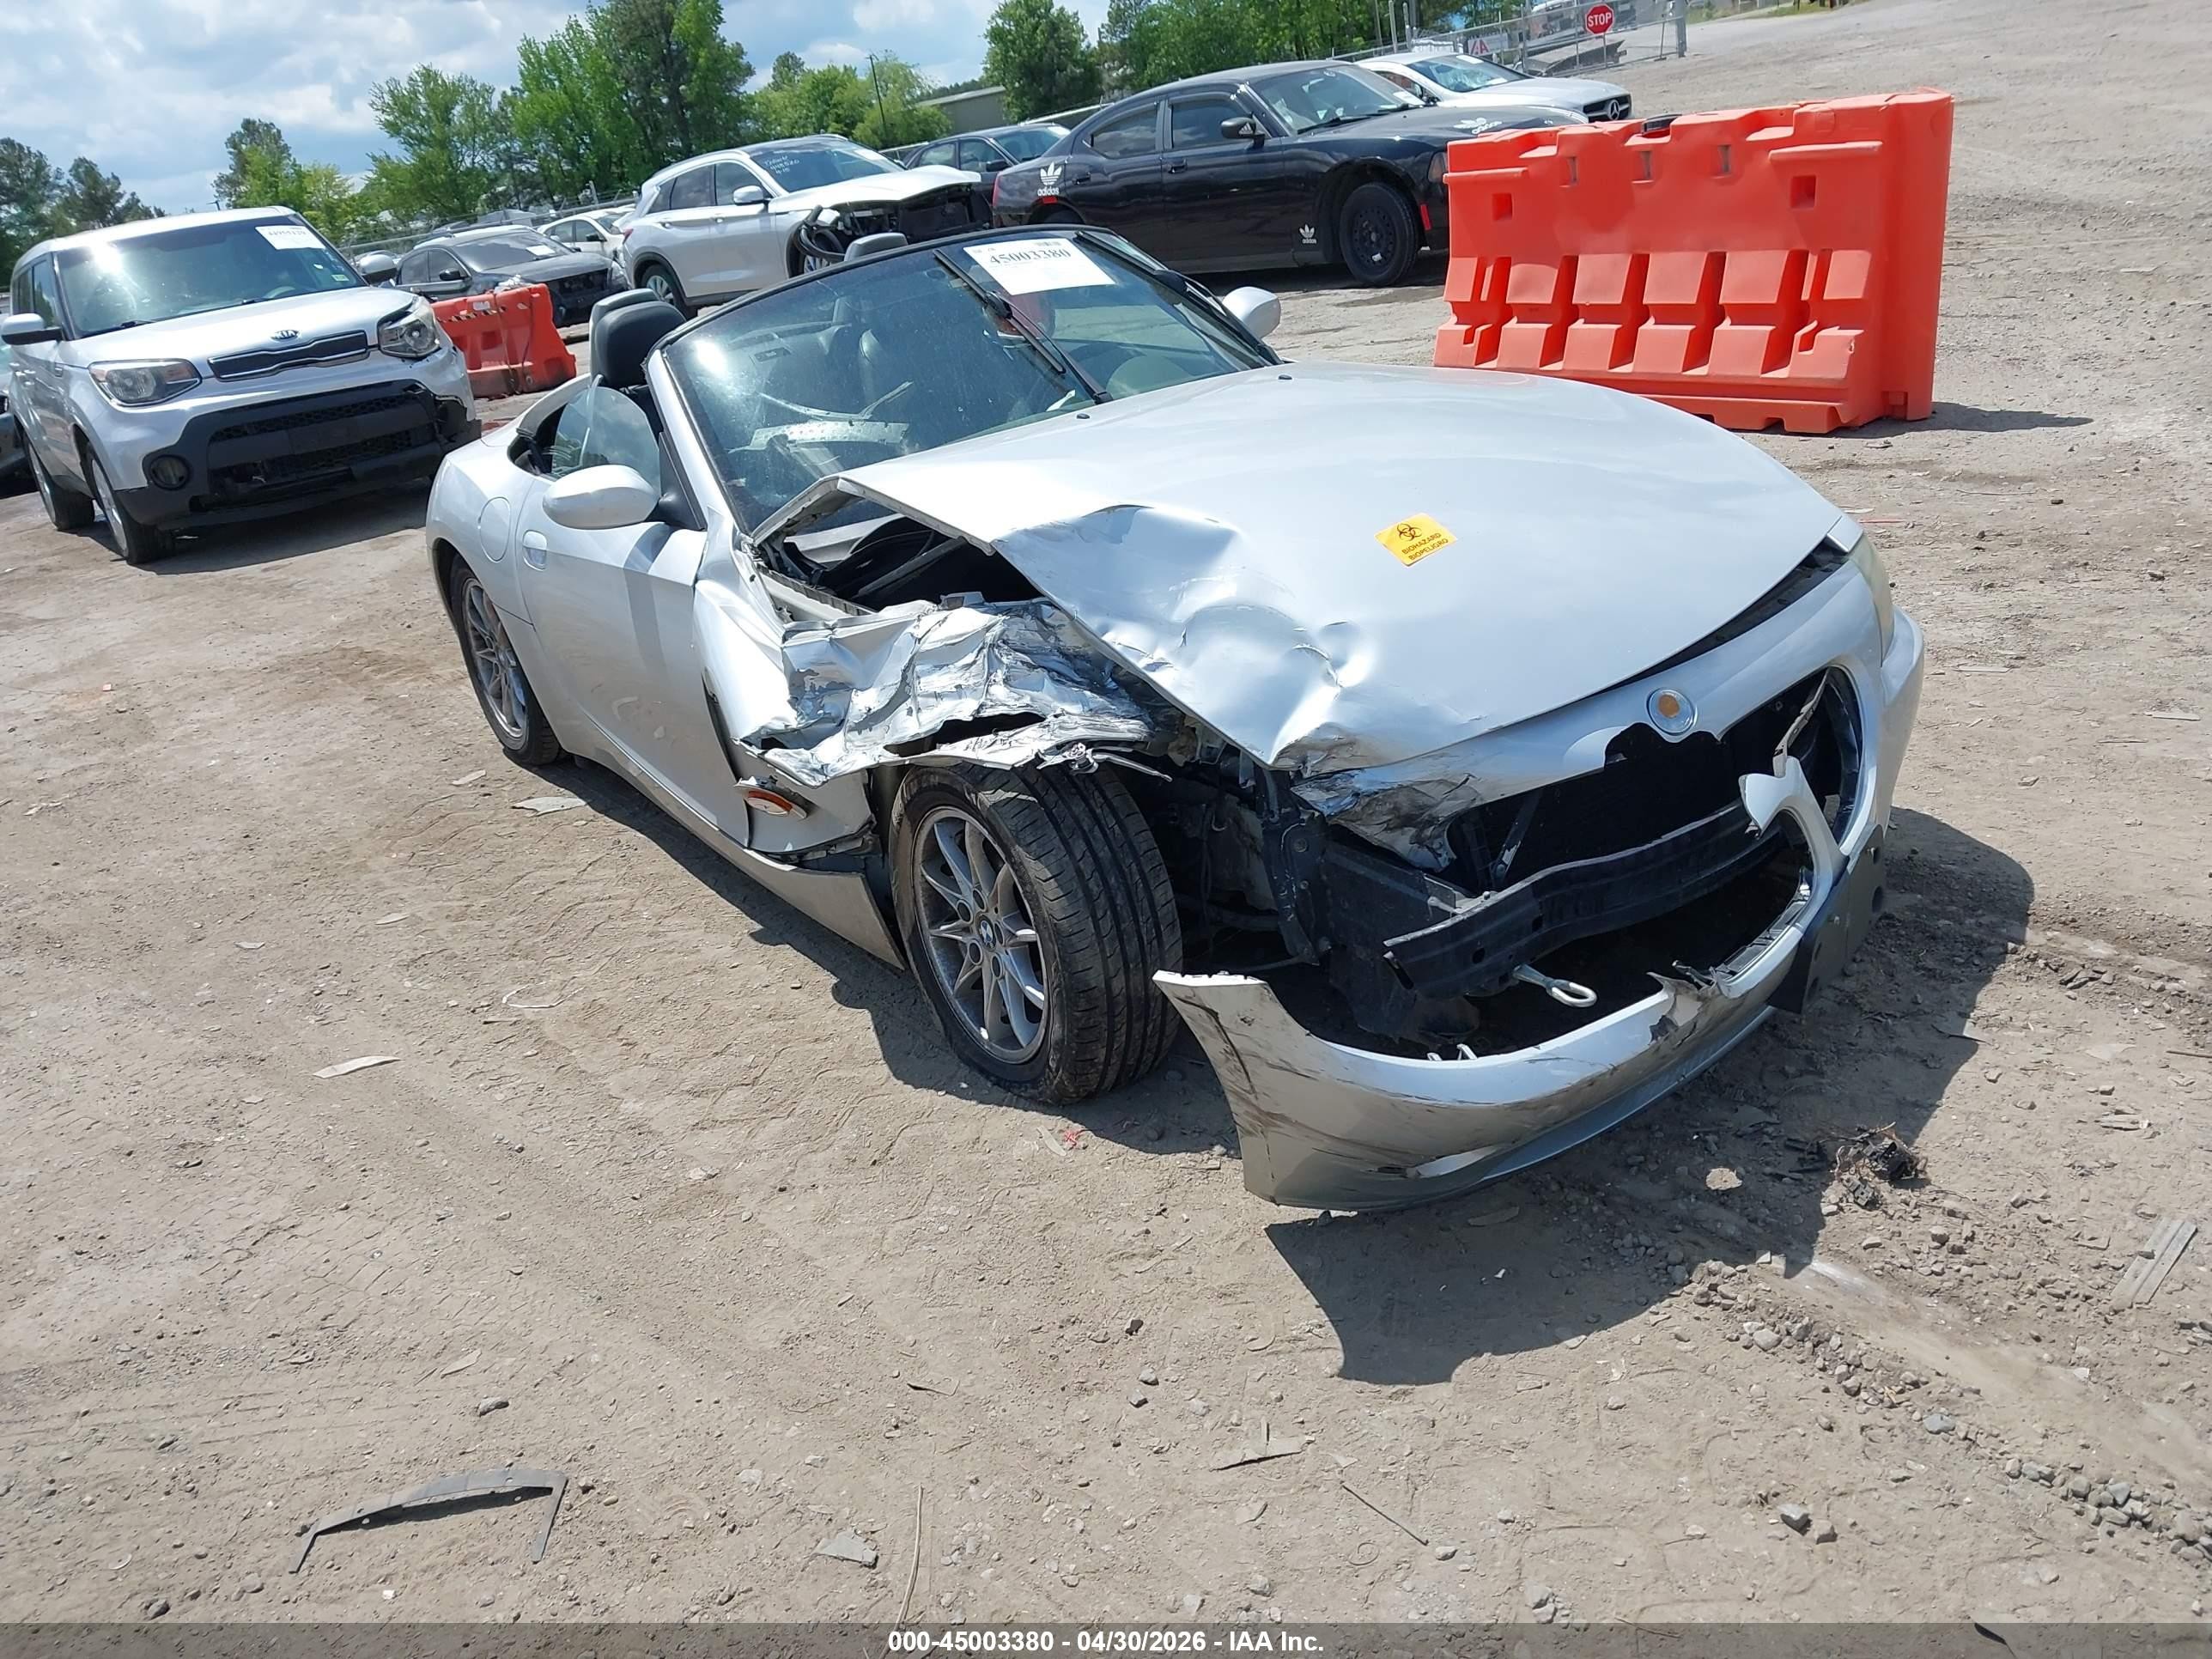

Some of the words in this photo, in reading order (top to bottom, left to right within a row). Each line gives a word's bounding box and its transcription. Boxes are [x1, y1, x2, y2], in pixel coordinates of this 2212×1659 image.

[1588, 12, 1612, 27] STOP
[1037, 185, 1060, 197] adidas
[990, 248, 1072, 264] 45003380
[273, 330, 297, 340] KIA
[1401, 532, 1442, 555] BIOHAZARD
[1408, 538, 1449, 560] BIOPELIGRO
